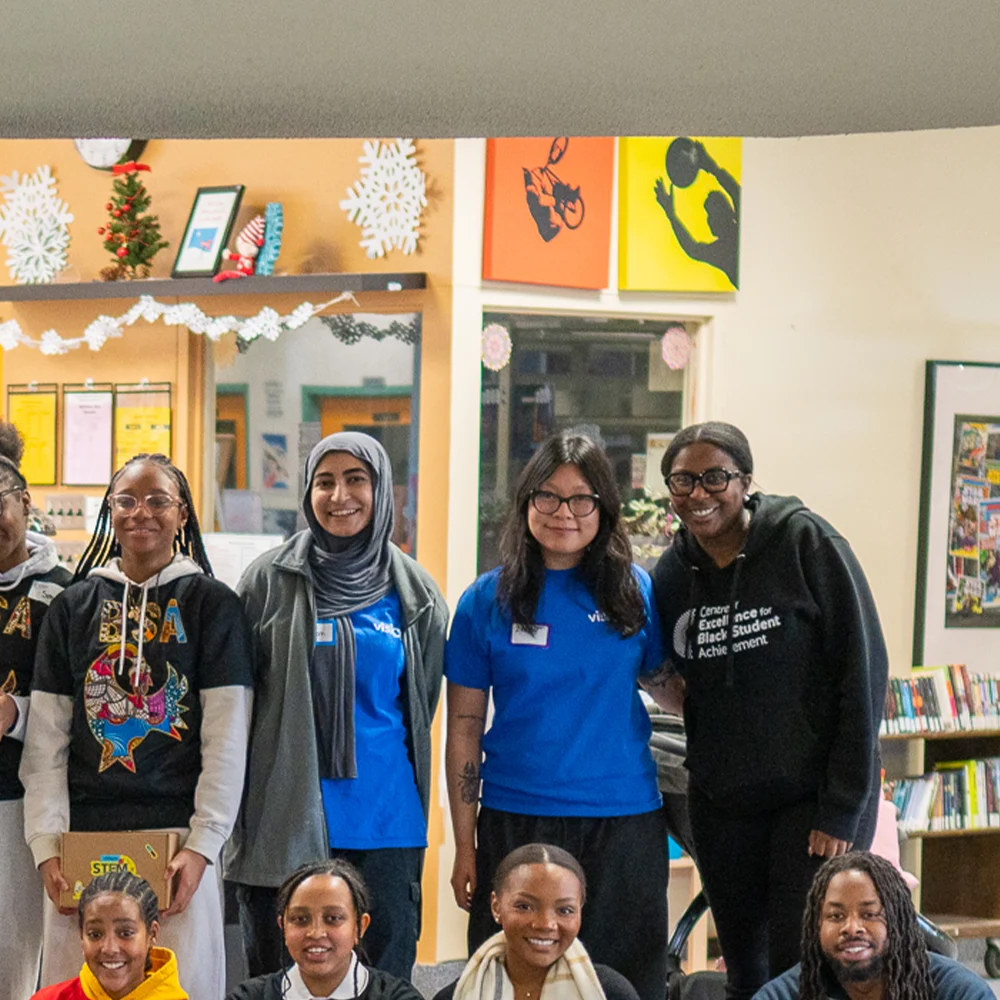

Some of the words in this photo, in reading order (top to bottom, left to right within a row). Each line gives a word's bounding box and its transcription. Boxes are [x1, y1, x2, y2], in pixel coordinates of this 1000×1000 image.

[99, 598, 188, 644] BSA
[699, 608, 758, 631] Excellnce
[759, 606, 773, 617] for
[700, 604, 730, 618] Centre
[697, 628, 728, 645] Black
[732, 615, 782, 648] Student
[698, 634, 769, 659] Achieement
